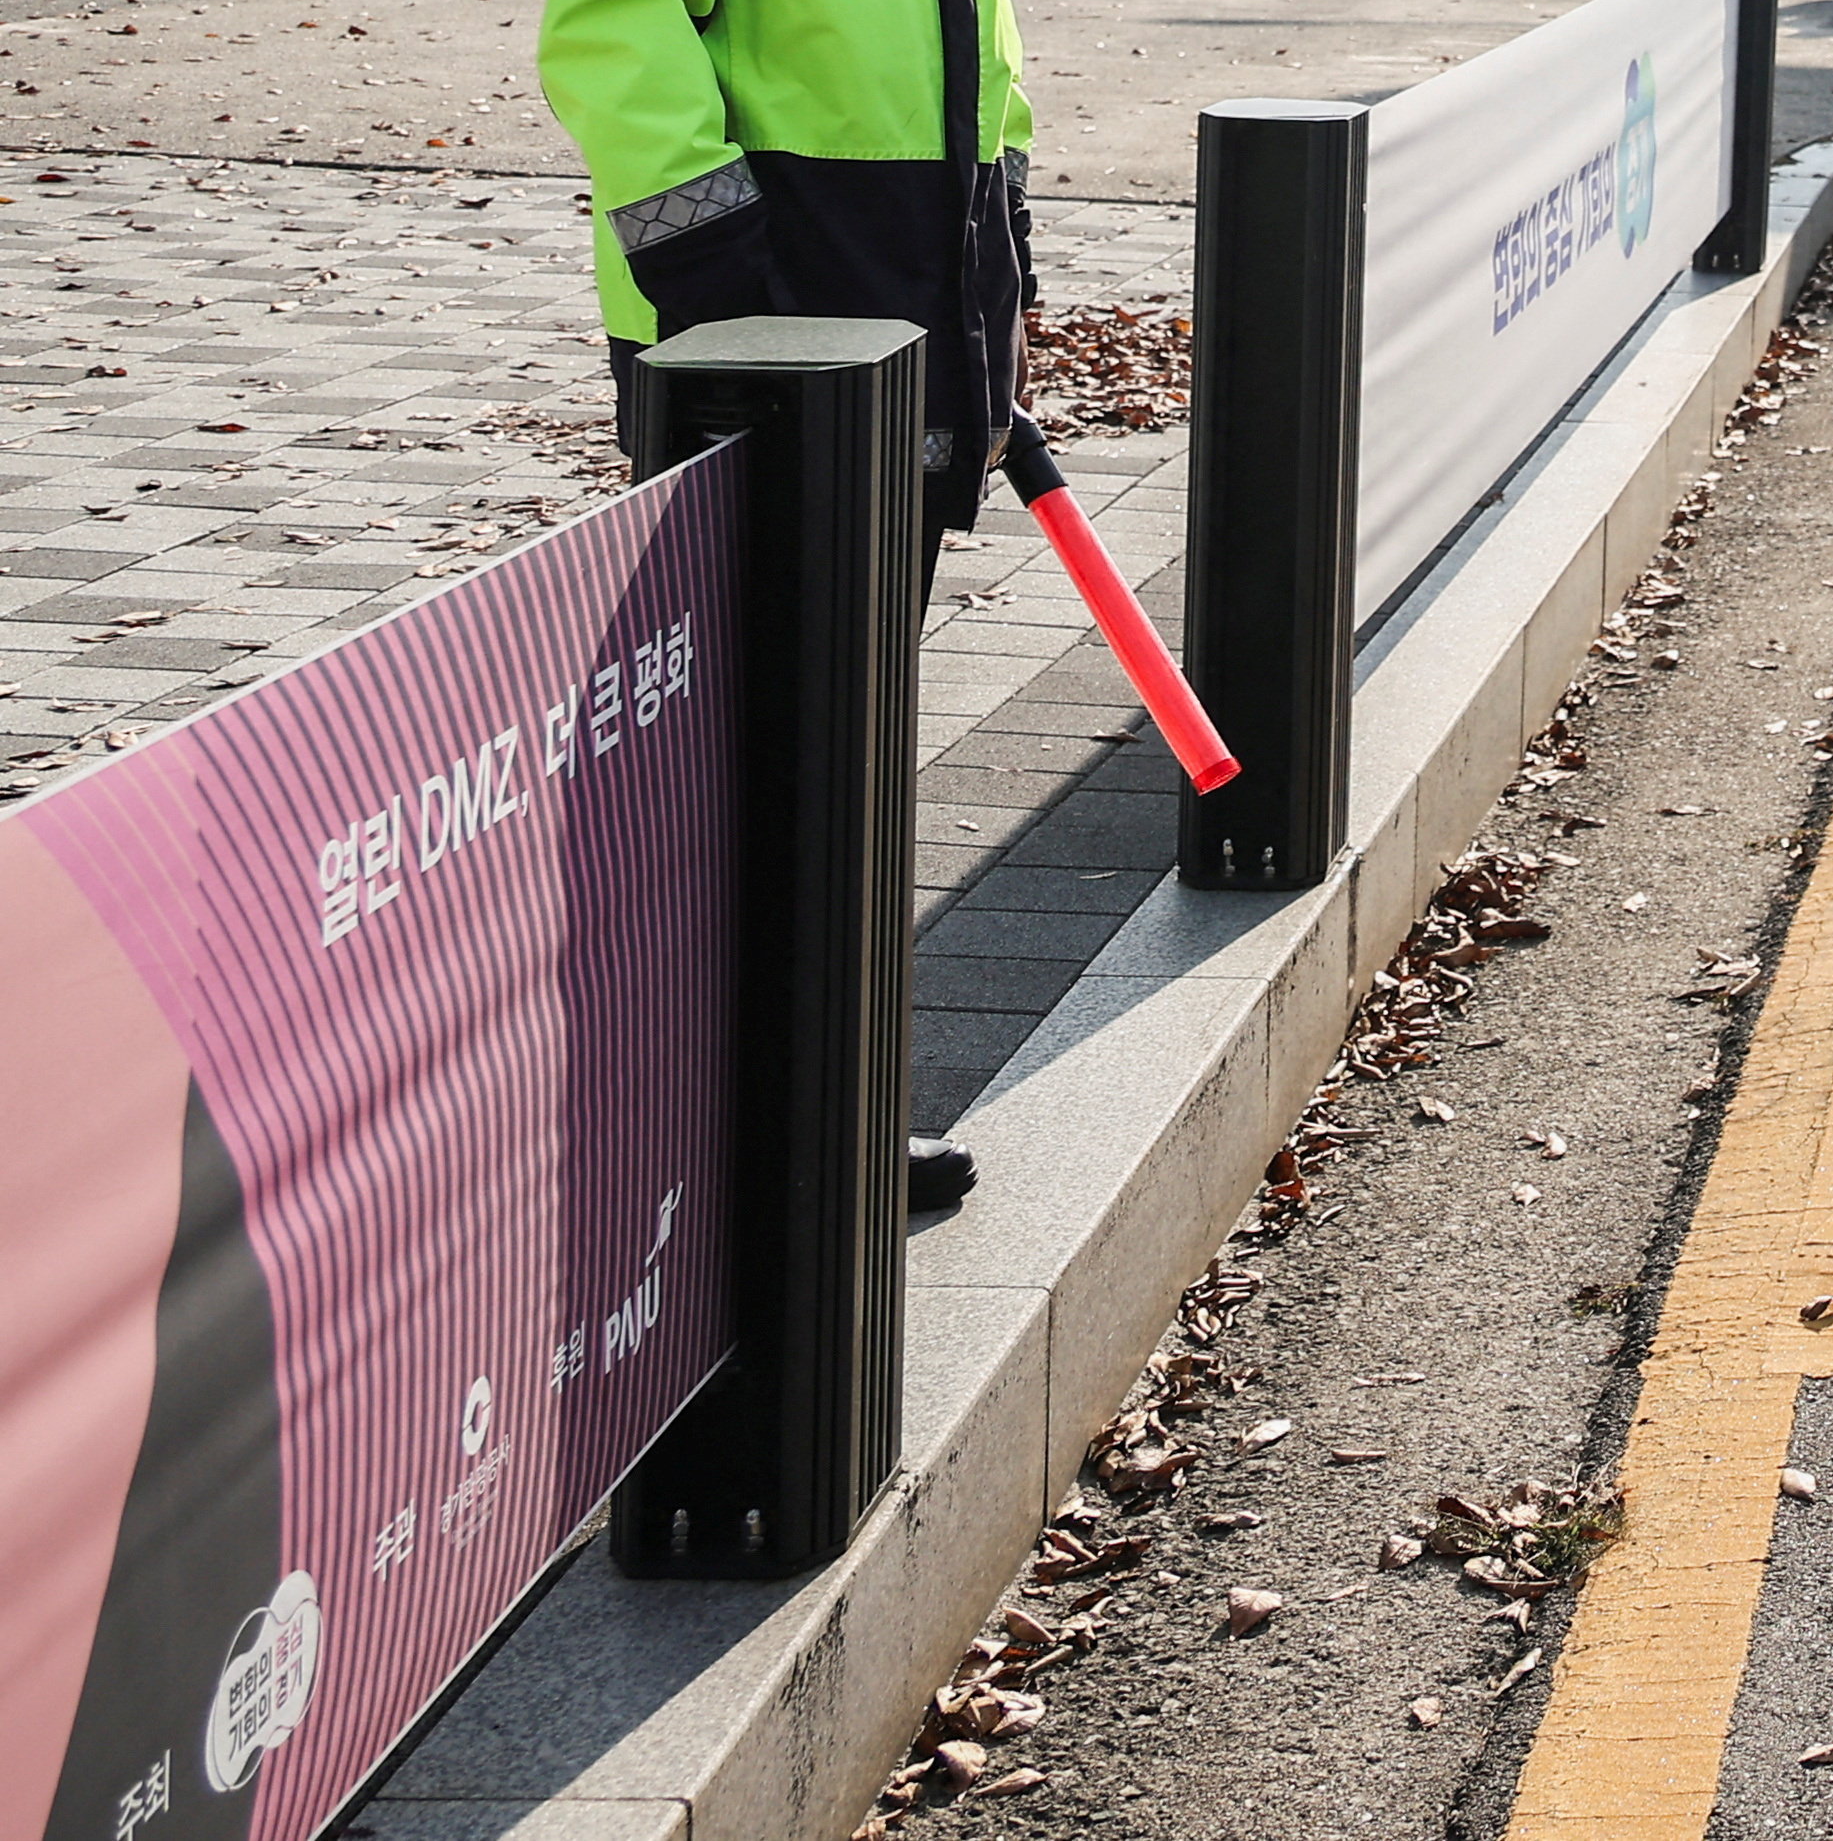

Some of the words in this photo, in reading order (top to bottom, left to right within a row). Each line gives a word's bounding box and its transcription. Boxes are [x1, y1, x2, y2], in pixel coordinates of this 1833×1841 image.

[319, 794, 401, 949] 열린
[420, 724, 529, 873] DMZ,
[546, 683, 577, 780] 더
[591, 660, 623, 758] 큰
[634, 610, 694, 728] 평화
[551, 1319, 585, 1394] 후원
[605, 1265, 660, 1375] PAJU
[373, 1498, 417, 1582] 주관
[229, 1646, 273, 1720] 변화의
[276, 1613, 304, 1669] 중심
[229, 1687, 272, 1762] 기회의
[276, 1654, 304, 1710] 경기
[116, 1748, 171, 1841] 주최
